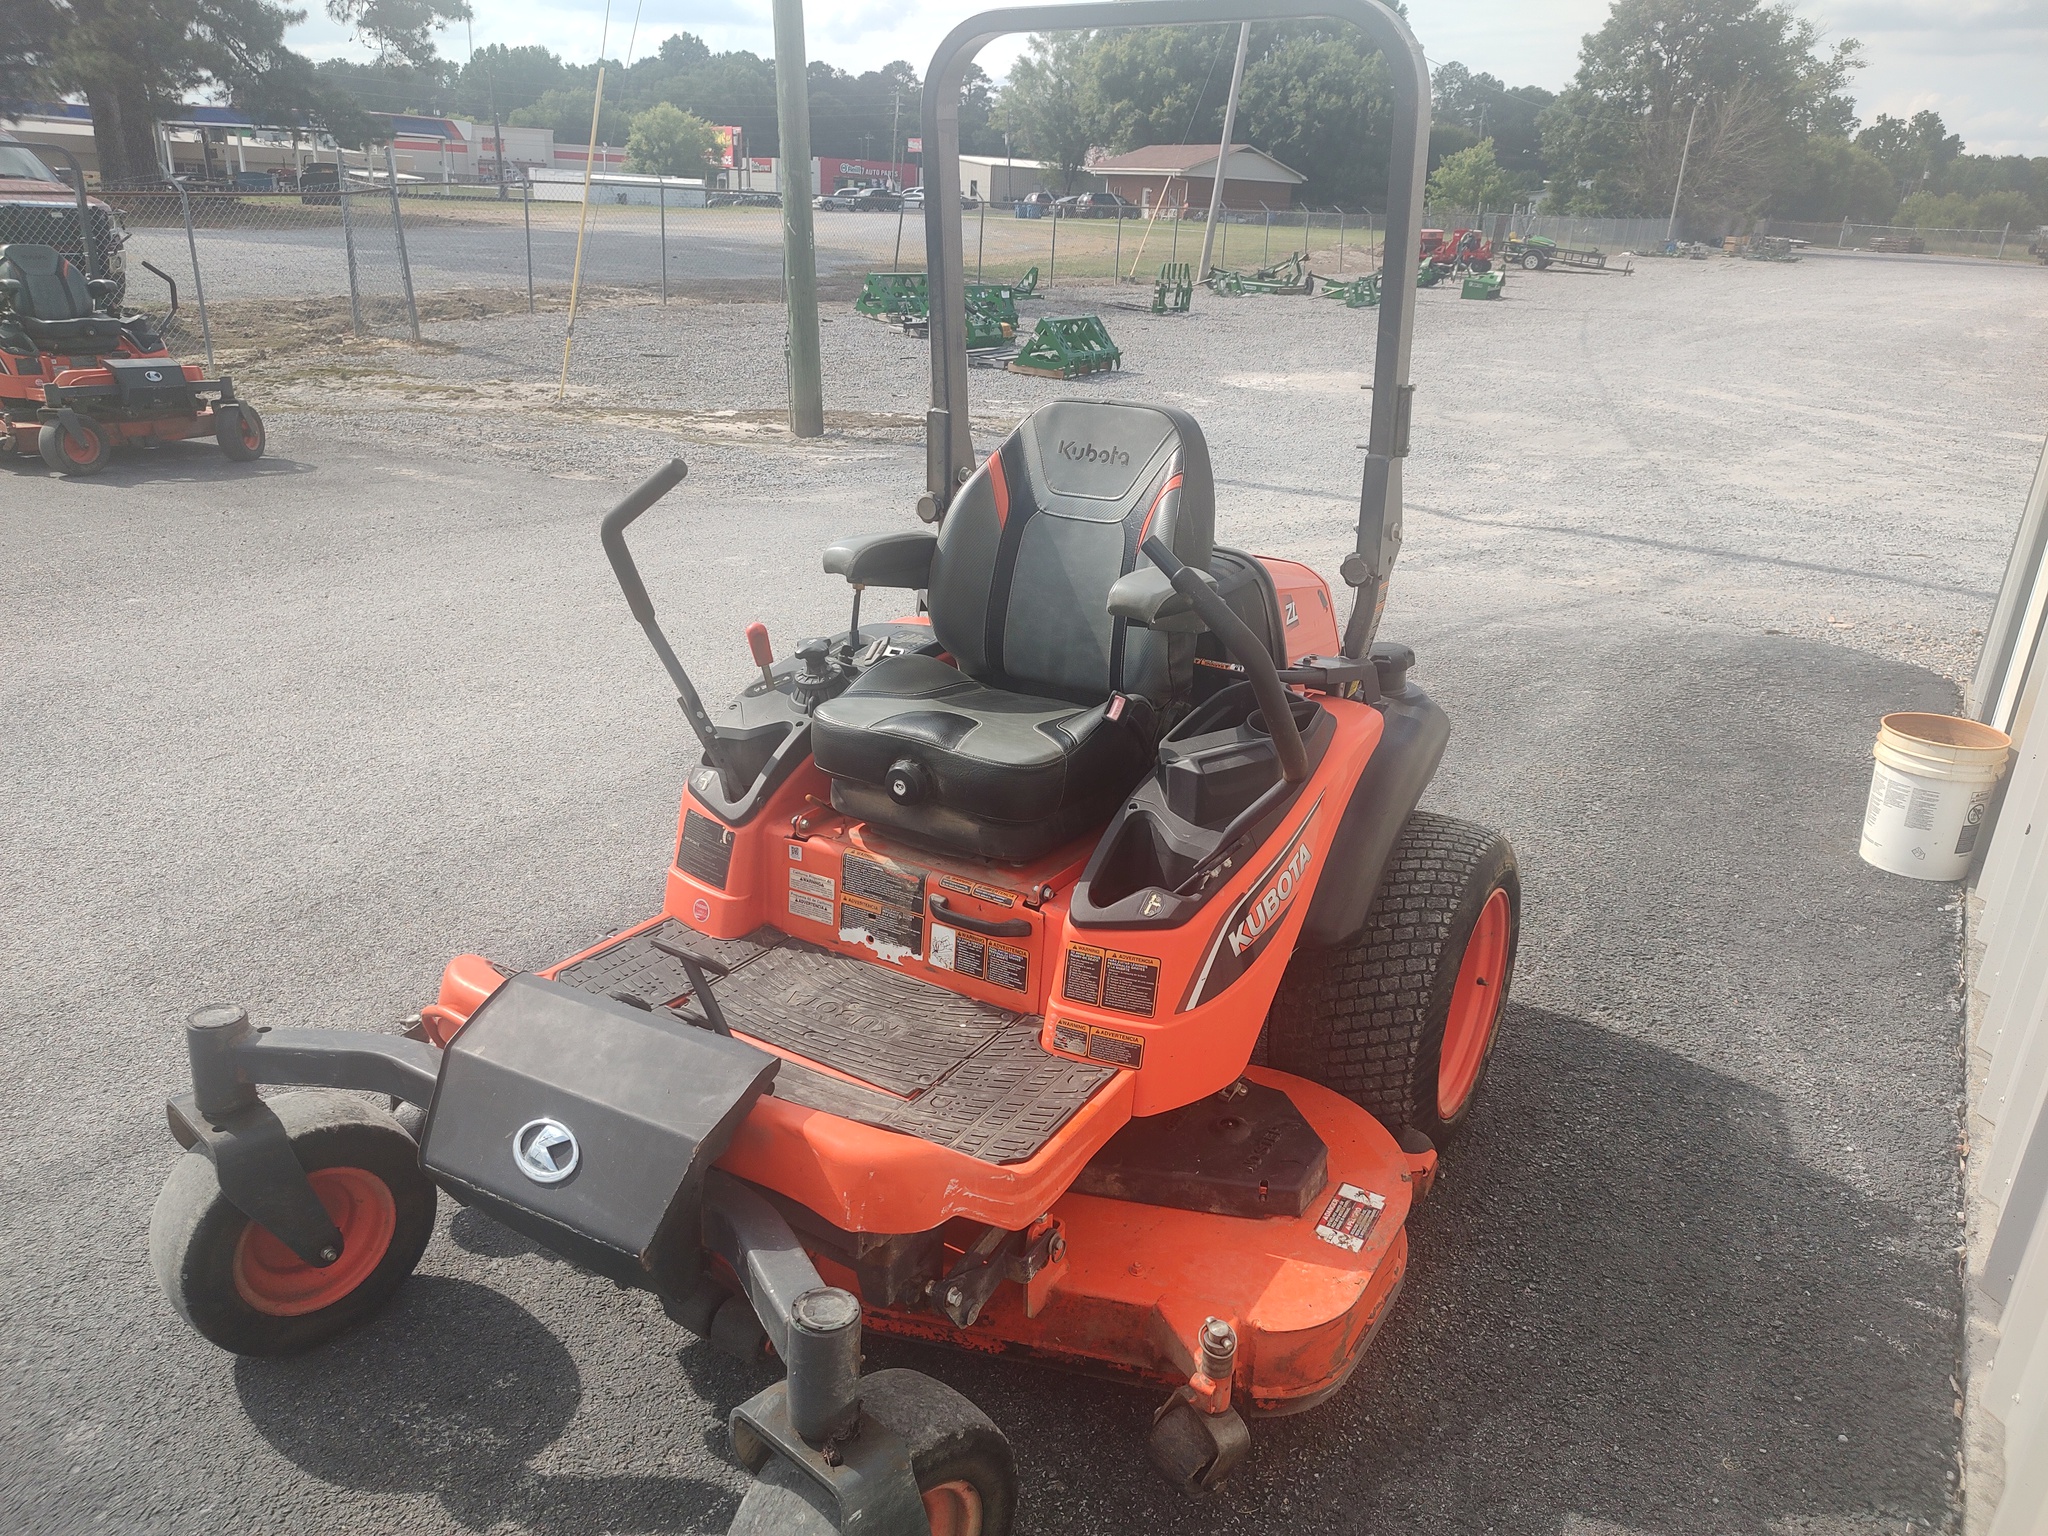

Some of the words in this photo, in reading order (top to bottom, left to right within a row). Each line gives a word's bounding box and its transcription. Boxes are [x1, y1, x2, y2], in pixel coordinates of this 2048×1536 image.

[1058, 440, 1130, 466] Kubota
[1228, 843, 1312, 957] KUBOTA
[962, 932, 985, 943] WARNING
[993, 942, 1027, 956] ADVERTENCIA
[1078, 946, 1100, 955] WARNING
[1118, 953, 1154, 965] ADVERTENCIA
[1061, 1021, 1086, 1031] WARNING
[1100, 1031, 1139, 1043] ADVERTENCIA
